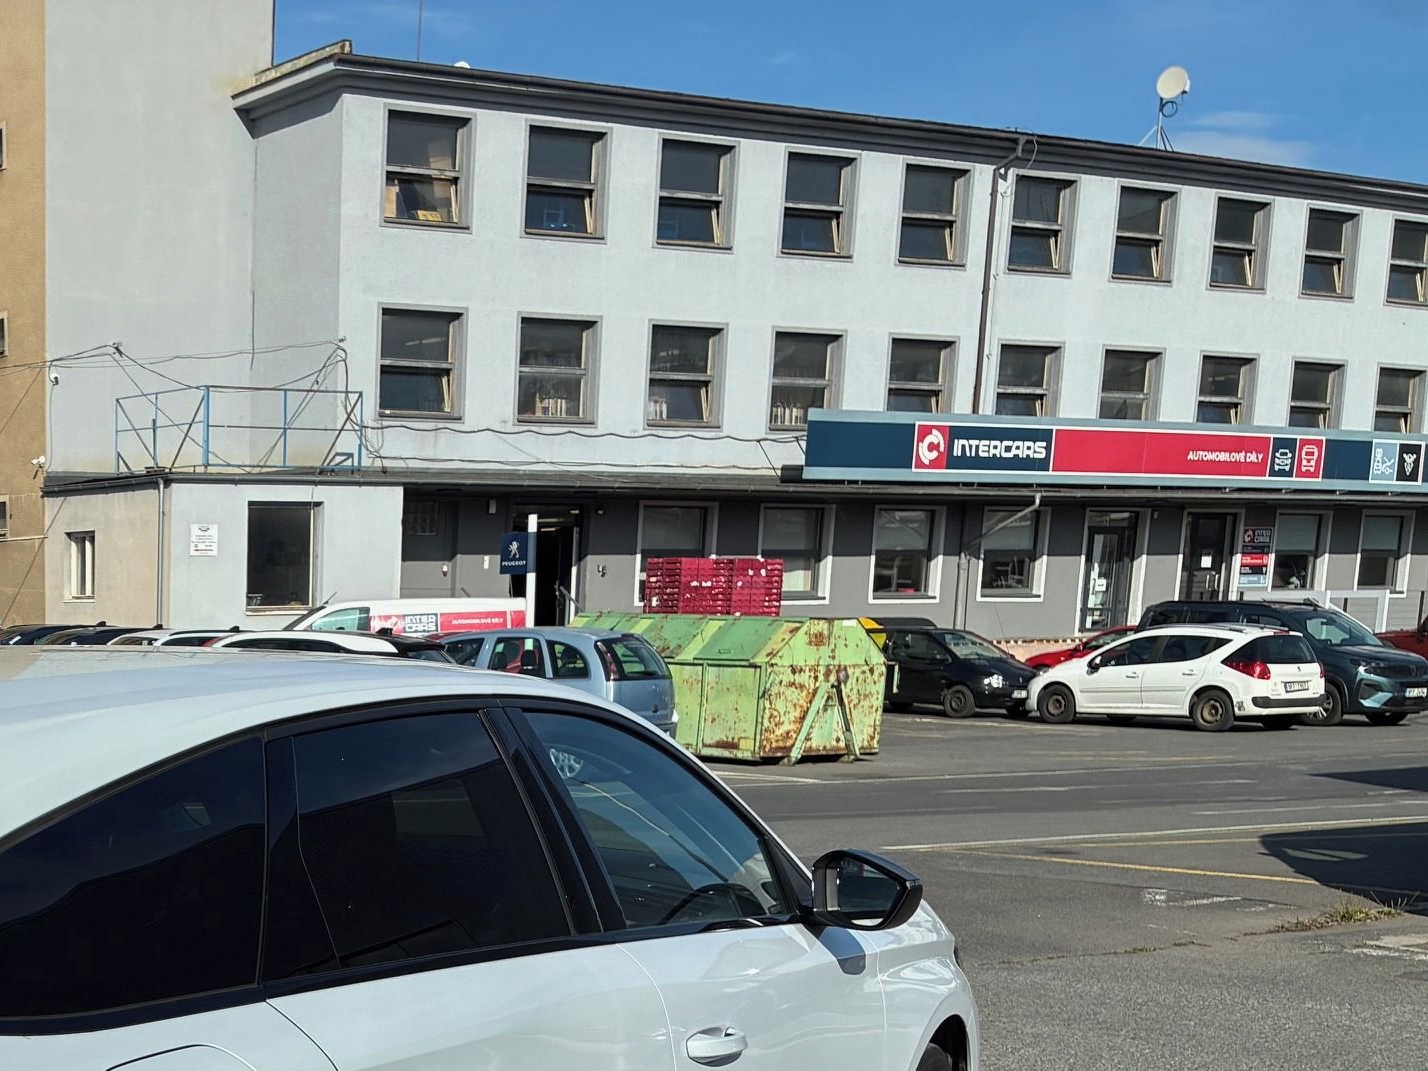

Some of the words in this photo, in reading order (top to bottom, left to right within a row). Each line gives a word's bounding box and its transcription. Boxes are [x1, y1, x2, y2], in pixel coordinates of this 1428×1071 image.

[953, 438, 1047, 459] INTERCARS
[1187, 450, 1245, 462] AUTOMOBILOVÉ
[1246, 451, 1264, 463] DÍLY
[405, 615, 436, 624] INTER
[405, 624, 437, 632] CARS
